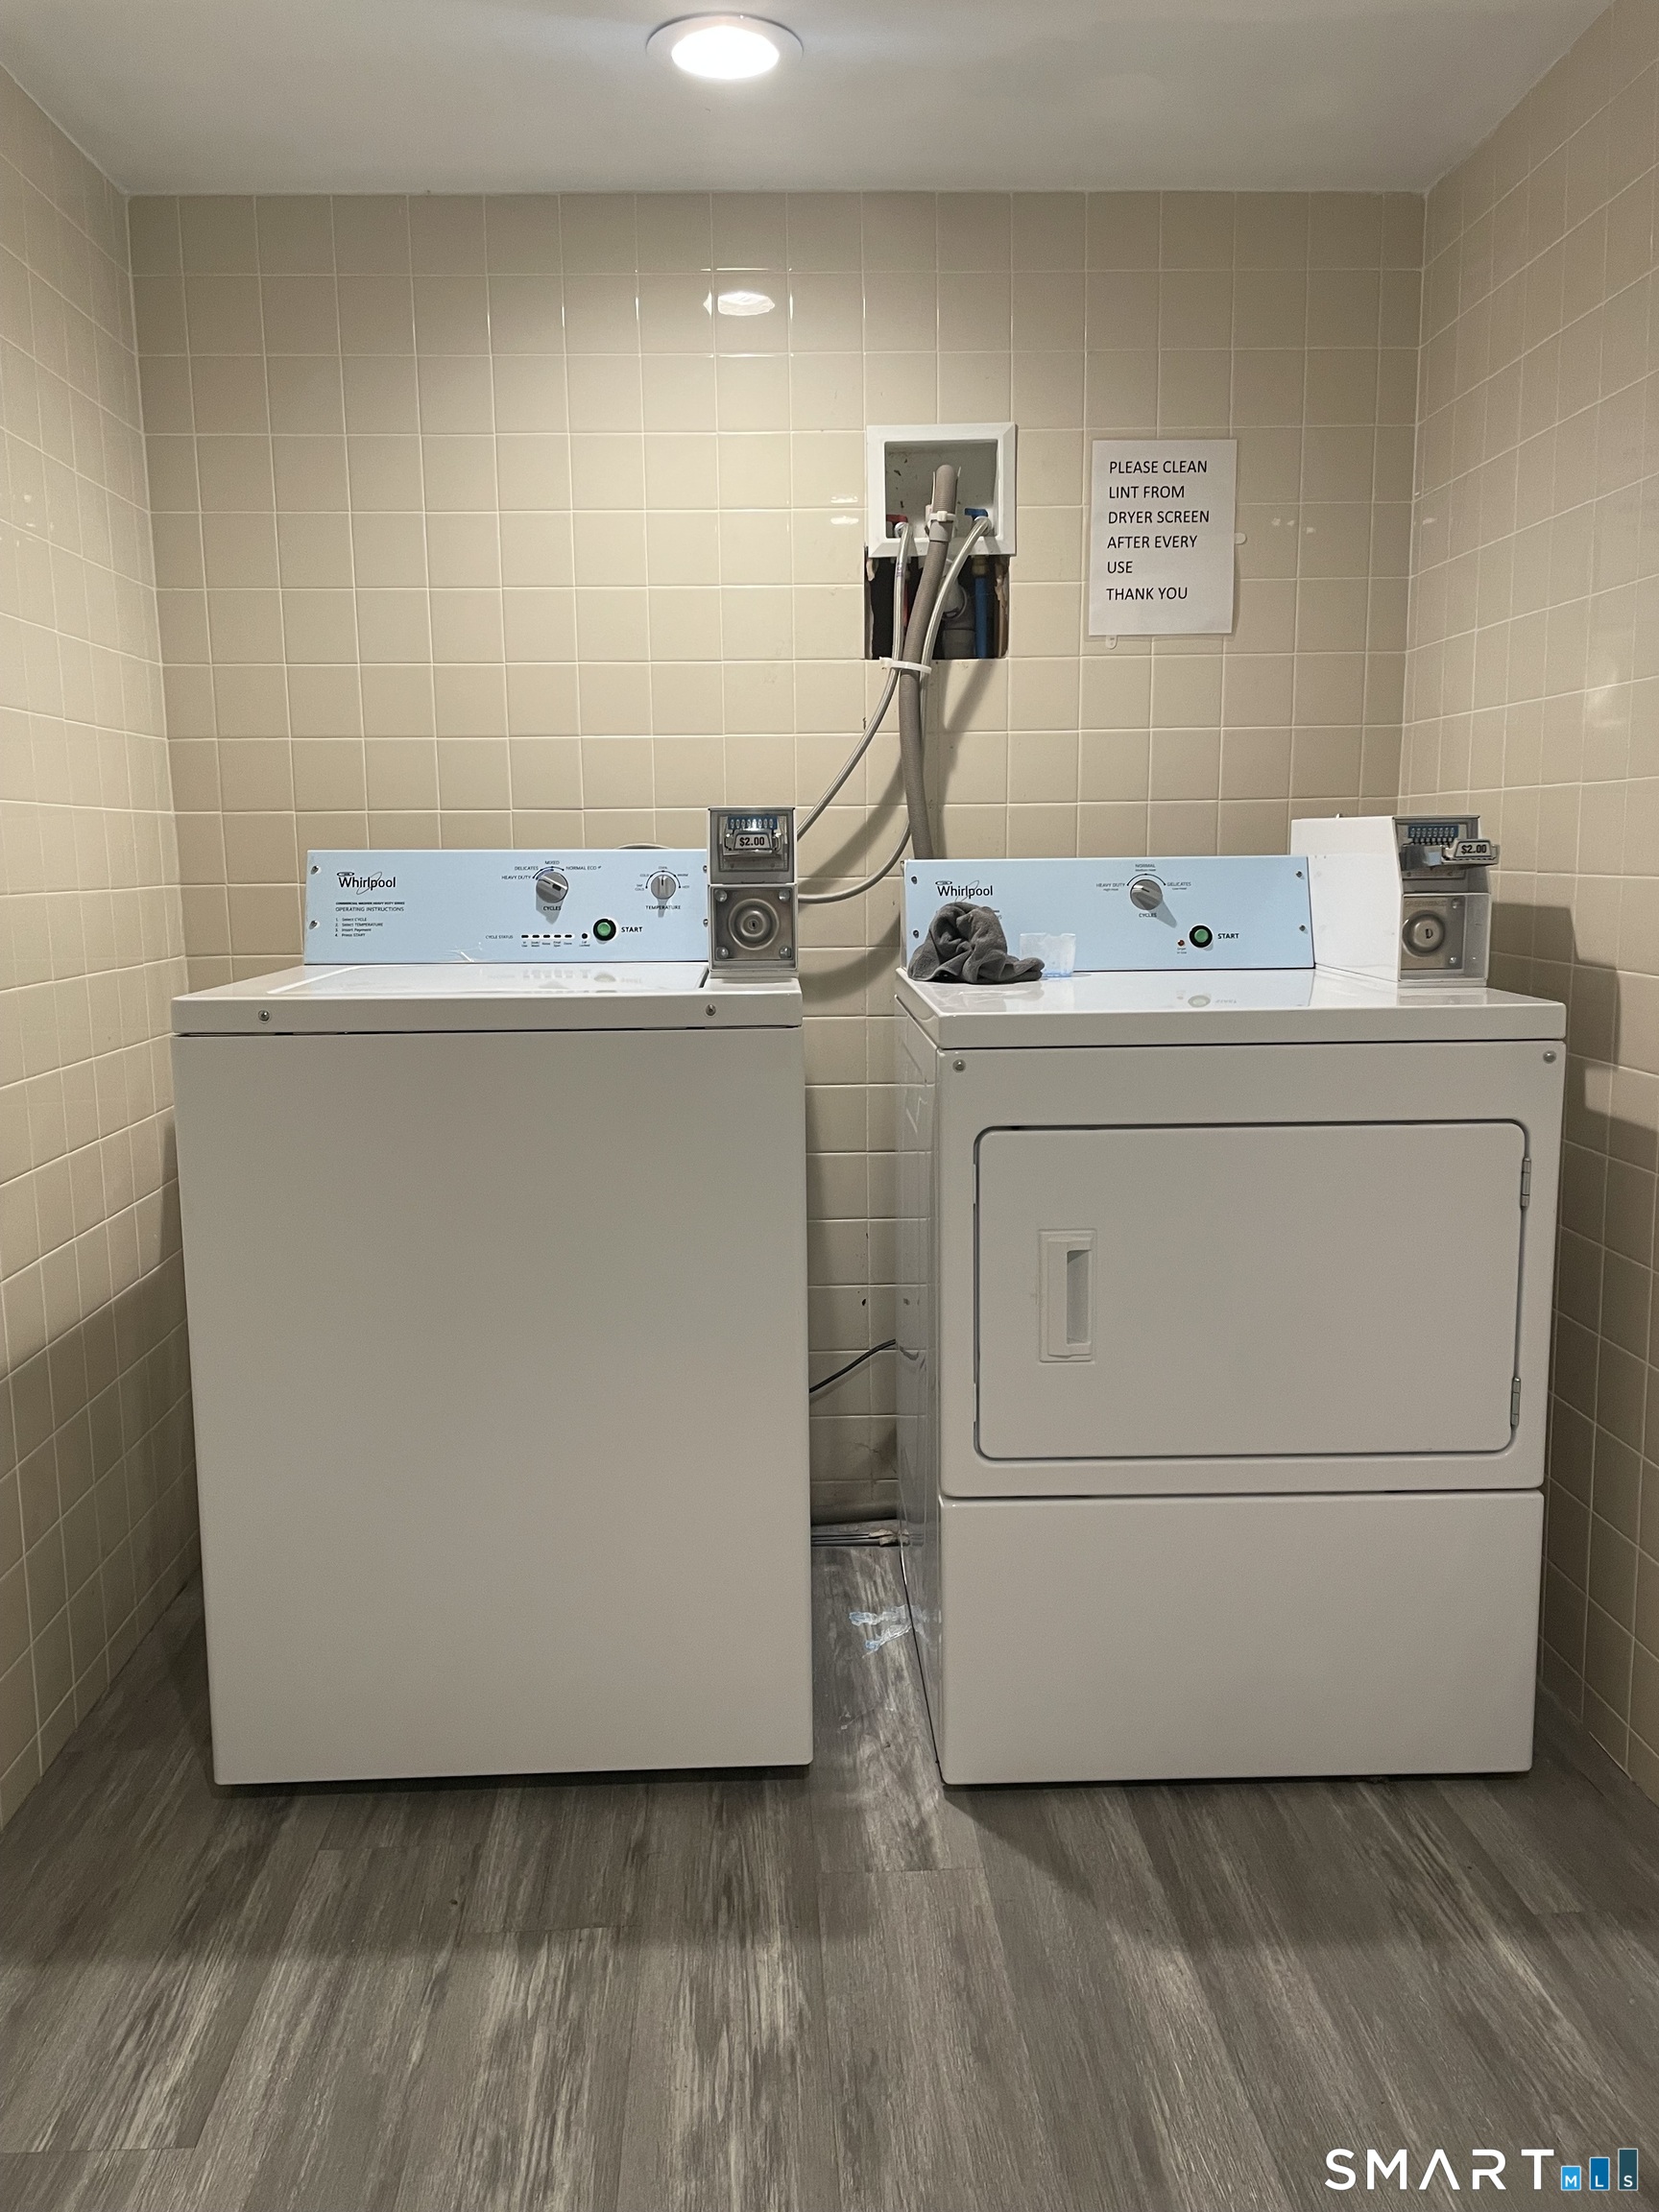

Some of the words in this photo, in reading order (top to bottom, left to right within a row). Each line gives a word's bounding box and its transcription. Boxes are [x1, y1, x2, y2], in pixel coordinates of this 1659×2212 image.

[1109, 460, 1159, 474] PLEASE
[1163, 460, 1208, 473] CLEAN
[1109, 486, 1140, 499] LINT
[1143, 485, 1185, 498] FROM
[1108, 511, 1153, 524] DRYER
[1157, 510, 1210, 523] SCREEN
[1107, 536, 1150, 549] AFTER
[1154, 535, 1198, 548] EVERY
[1107, 561, 1133, 574] USE
[1106, 588, 1154, 601] THANK
[1158, 587, 1188, 600] YOU
[739, 836, 765, 847] $2.00
[1460, 844, 1487, 854] $2.00
[338, 877, 396, 891] Whirlpool
[937, 885, 993, 900] Whirlpool
